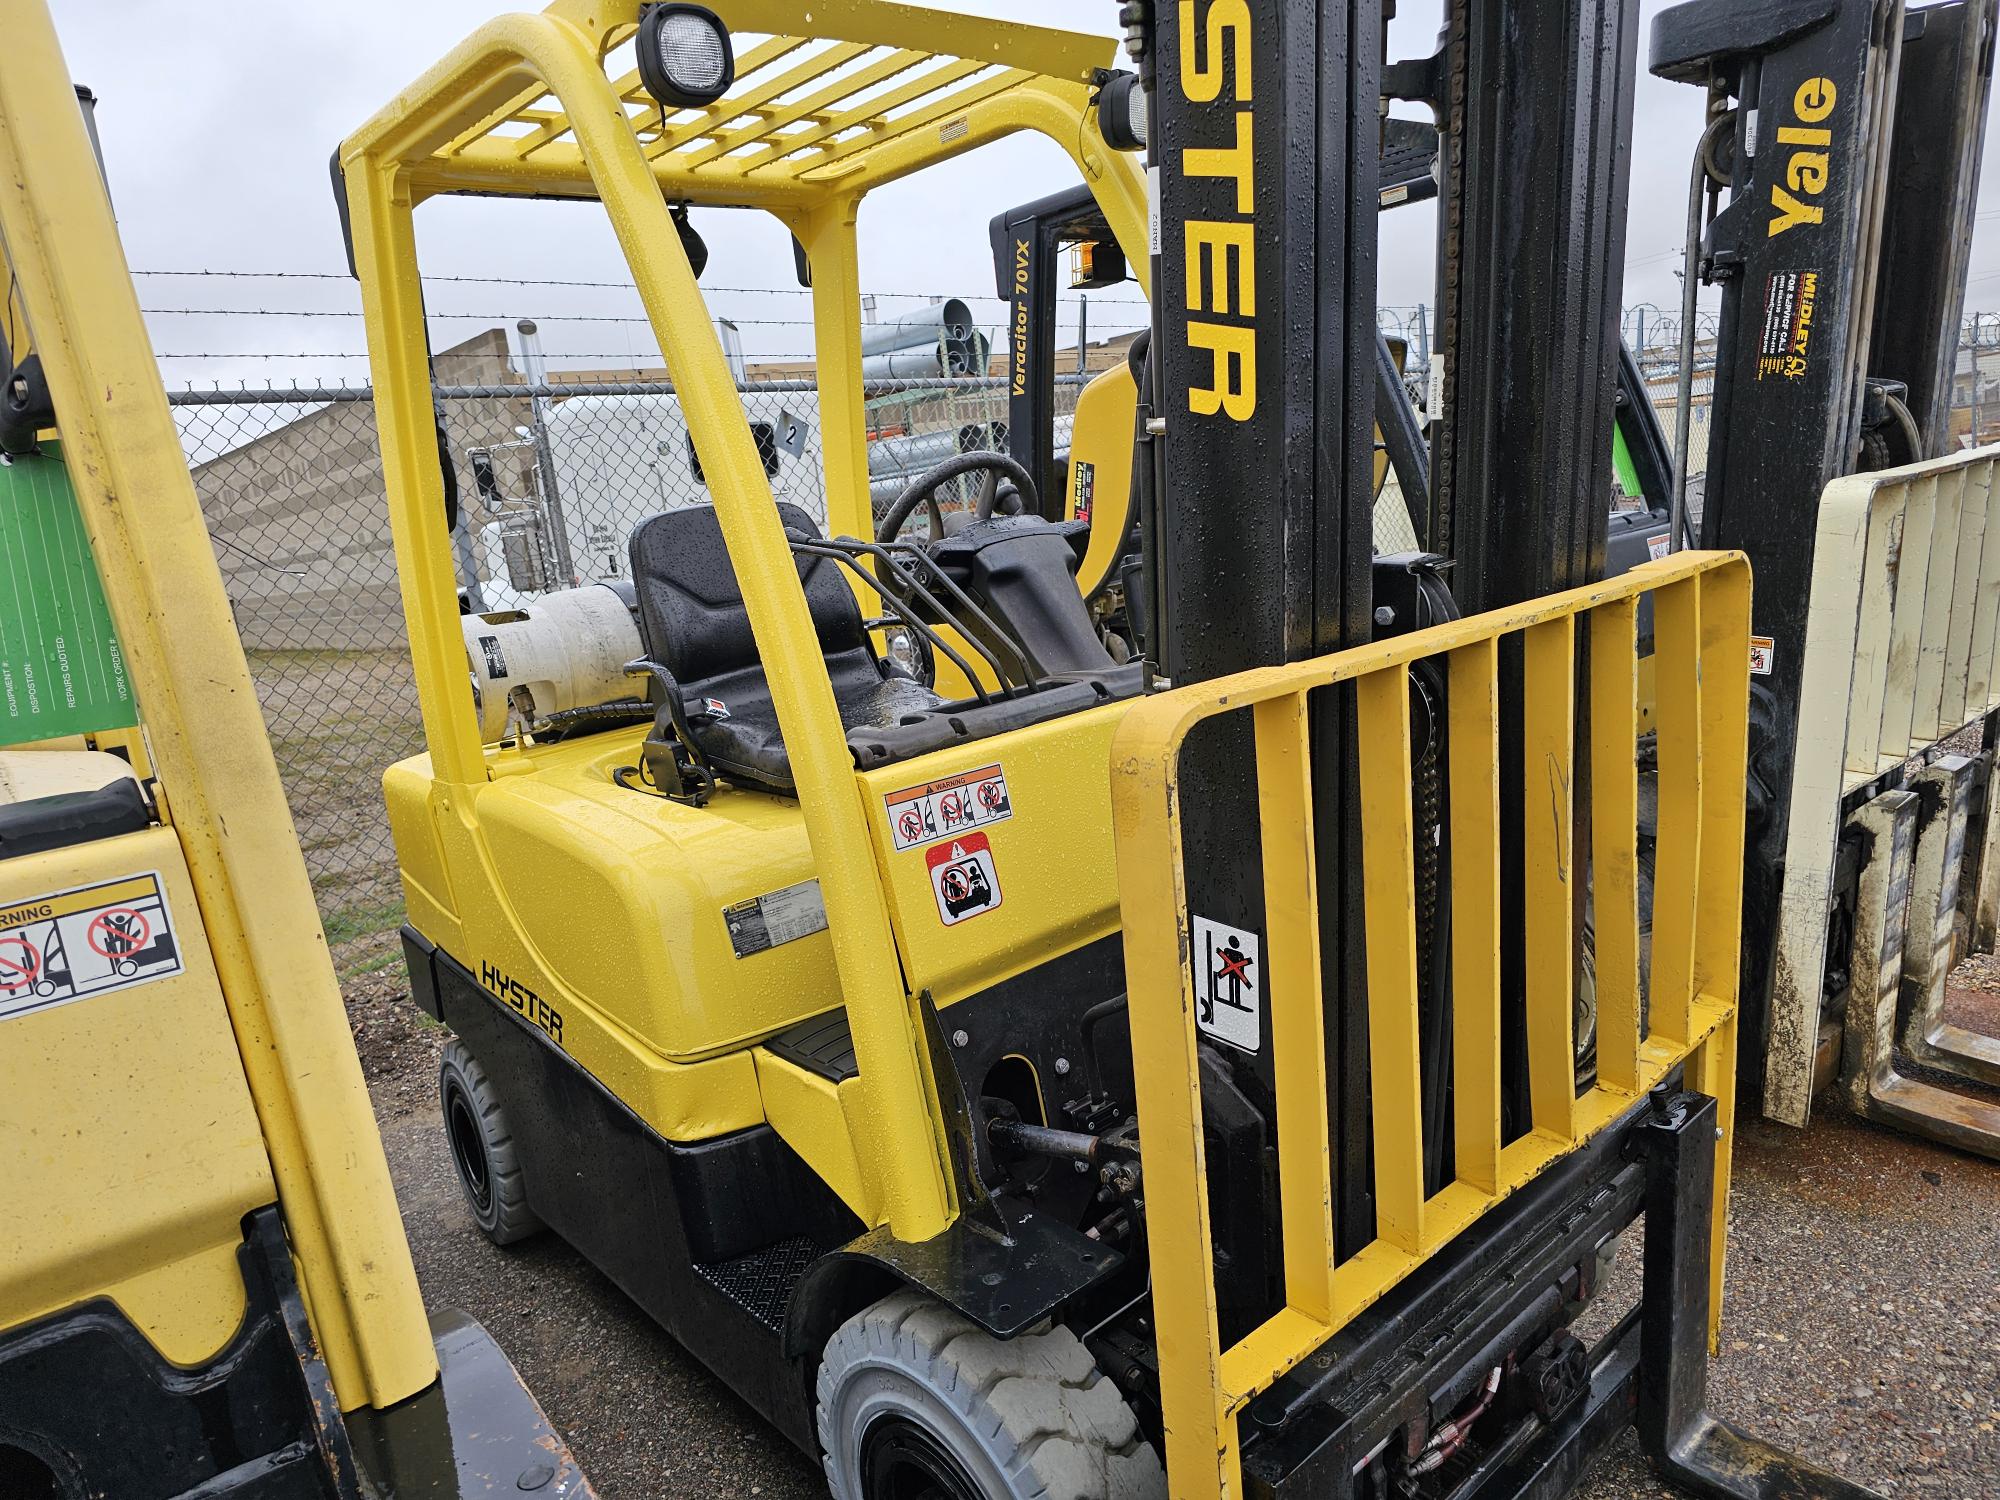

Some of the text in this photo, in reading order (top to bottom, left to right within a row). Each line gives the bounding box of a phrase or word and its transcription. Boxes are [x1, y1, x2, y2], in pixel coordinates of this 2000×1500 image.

[1767, 76, 1838, 238] Yale
[1787, 273, 1797, 291] FOR
[1012, 239, 1030, 397] Veracitor 70VX
[785, 425, 797, 446] 2
[110, 645, 123, 674] ORDER
[3, 670, 18, 717] EQUIPMENT
[62, 673, 77, 709] REPAIRS
[115, 676, 128, 702] WORK
[935, 777, 966, 791] WARNING
[481, 959, 564, 1044] HYSTER
